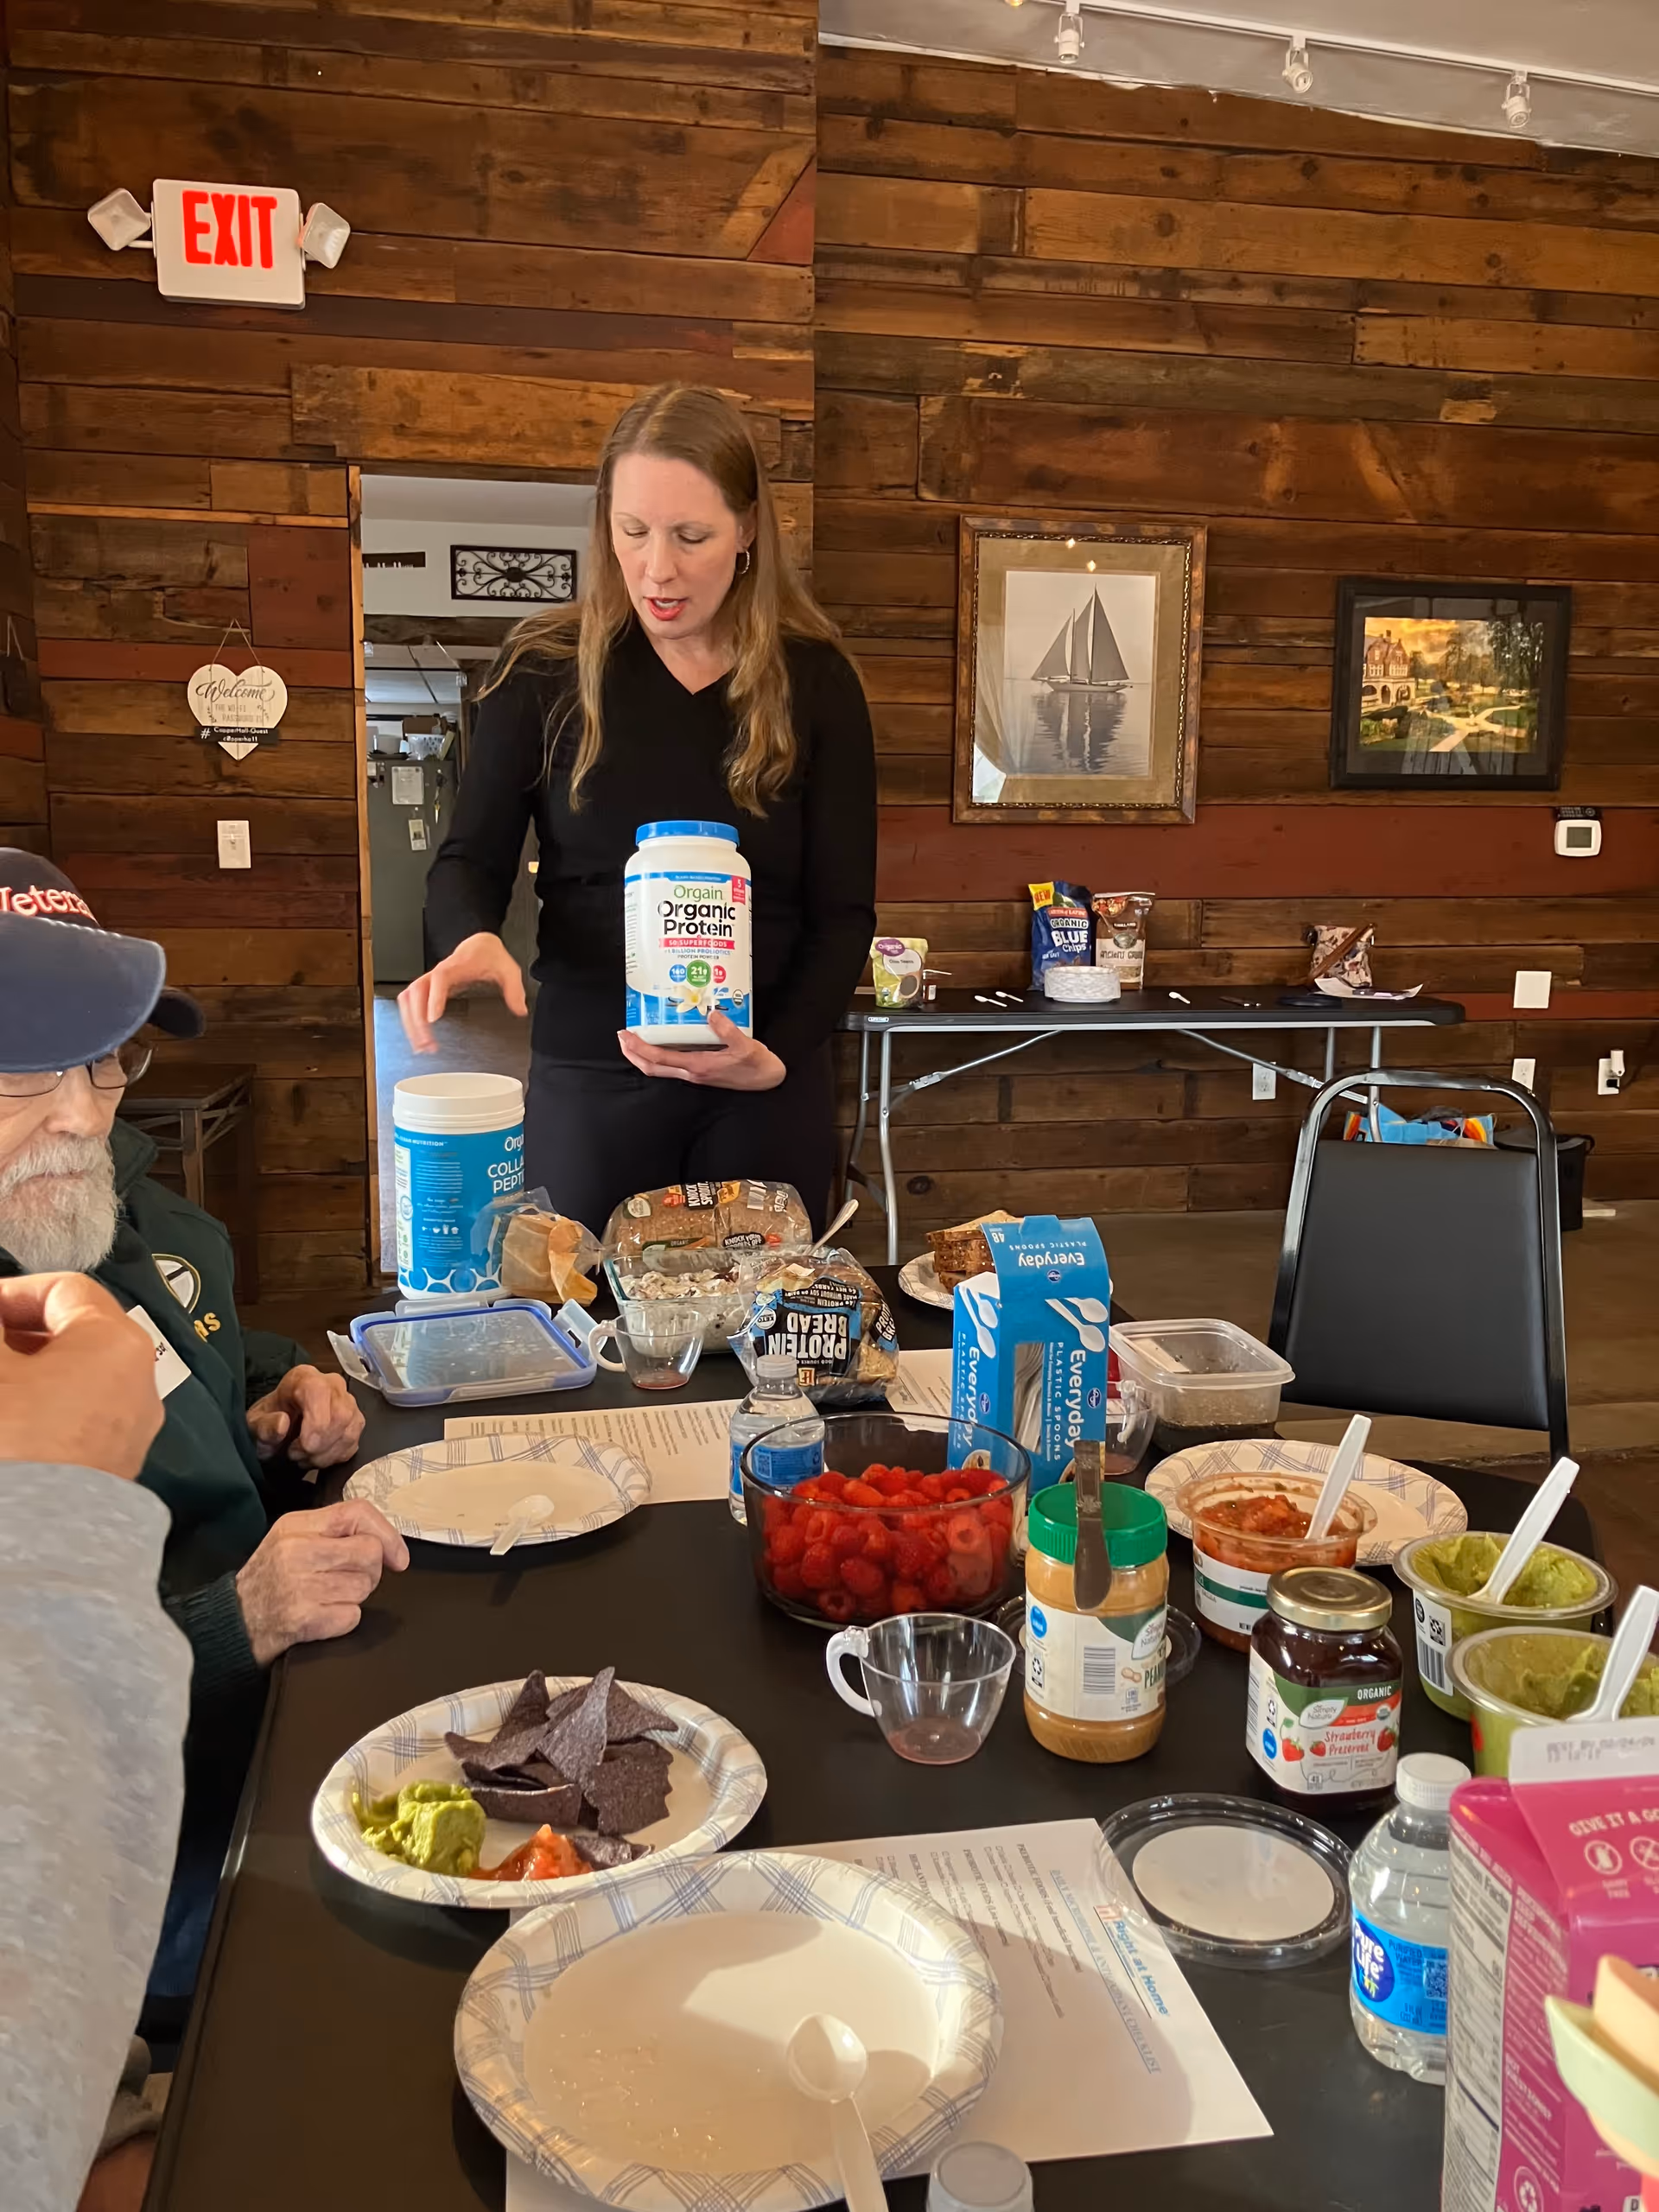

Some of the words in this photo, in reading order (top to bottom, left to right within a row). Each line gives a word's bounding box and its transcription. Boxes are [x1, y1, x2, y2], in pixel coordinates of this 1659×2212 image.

[182, 189, 277, 269] EXIT
[195, 678, 276, 702] Welcome
[737, 879, 741, 887] 5
[674, 885, 723, 902] Orgain
[1033, 889, 1051, 902] NEW
[658, 900, 736, 920] Organic
[664, 919, 733, 938] Protein
[1051, 918, 1088, 929] ORGANIC
[678, 939, 728, 948] SUPERFOODS
[1052, 931, 1089, 947] BLUE
[1062, 943, 1087, 953] Chips
[691, 966, 708, 976] 21g
[725, 1235, 746, 1246] KNOCK
[992, 1232, 1005, 1243] 48
[1009, 1243, 1046, 1251] SPOONS
[1018, 1251, 1085, 1269] Everyday
[817, 1298, 844, 1307] PROTEIN
[787, 1313, 848, 1338] BREAD
[768, 1333, 847, 1359] PROTEIN
[1054, 1342, 1065, 1398] PLASTIC
[963, 1346, 981, 1447] Everyday
[1065, 1349, 1086, 1448] Everyday
[1053, 1406, 1062, 1461] SPOONS
[1357, 1686, 1392, 1700] ORGANIC
[1307, 1712, 1332, 1720] Nature
[1313, 1705, 1338, 1715] Simply
[1324, 1730, 1376, 1747] Strawberry
[1328, 1743, 1370, 1757] Preserves
[1568, 1815, 1608, 1838] GIVE
[1605, 1812, 1625, 1828] IT
[1628, 1810, 1642, 1825] A
[1355, 1923, 1384, 1962] Pure
[1389, 1939, 1423, 1959] PURIFIED
[1356, 1942, 1382, 1980] Life
[1395, 1950, 1422, 1967] WATER
[1113, 1920, 1138, 1955] Right
[1133, 1957, 1147, 1972] at
[1141, 1974, 1170, 2016] Home
